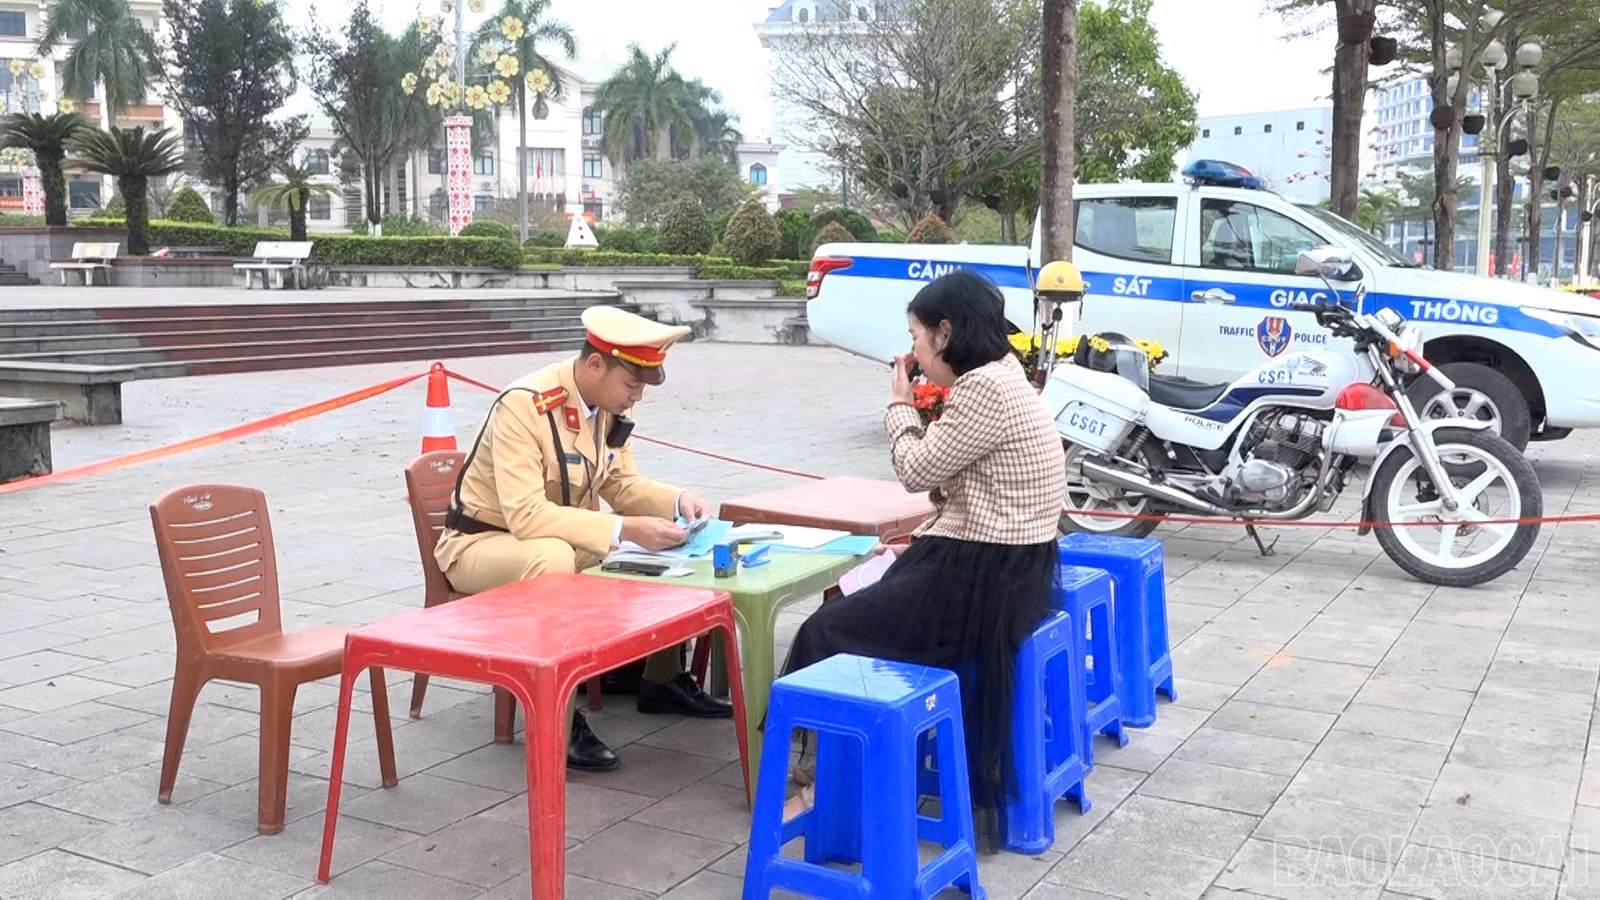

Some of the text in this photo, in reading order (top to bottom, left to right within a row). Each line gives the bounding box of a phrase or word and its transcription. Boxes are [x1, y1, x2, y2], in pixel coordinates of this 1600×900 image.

[1112, 275, 1152, 297] SÁT
[1410, 299, 1498, 325] THÔNG
[1219, 325, 1327, 345] TRAFFIC POLICE
[1070, 412, 1107, 437] CSGT
[1184, 416, 1224, 431] POLICE
